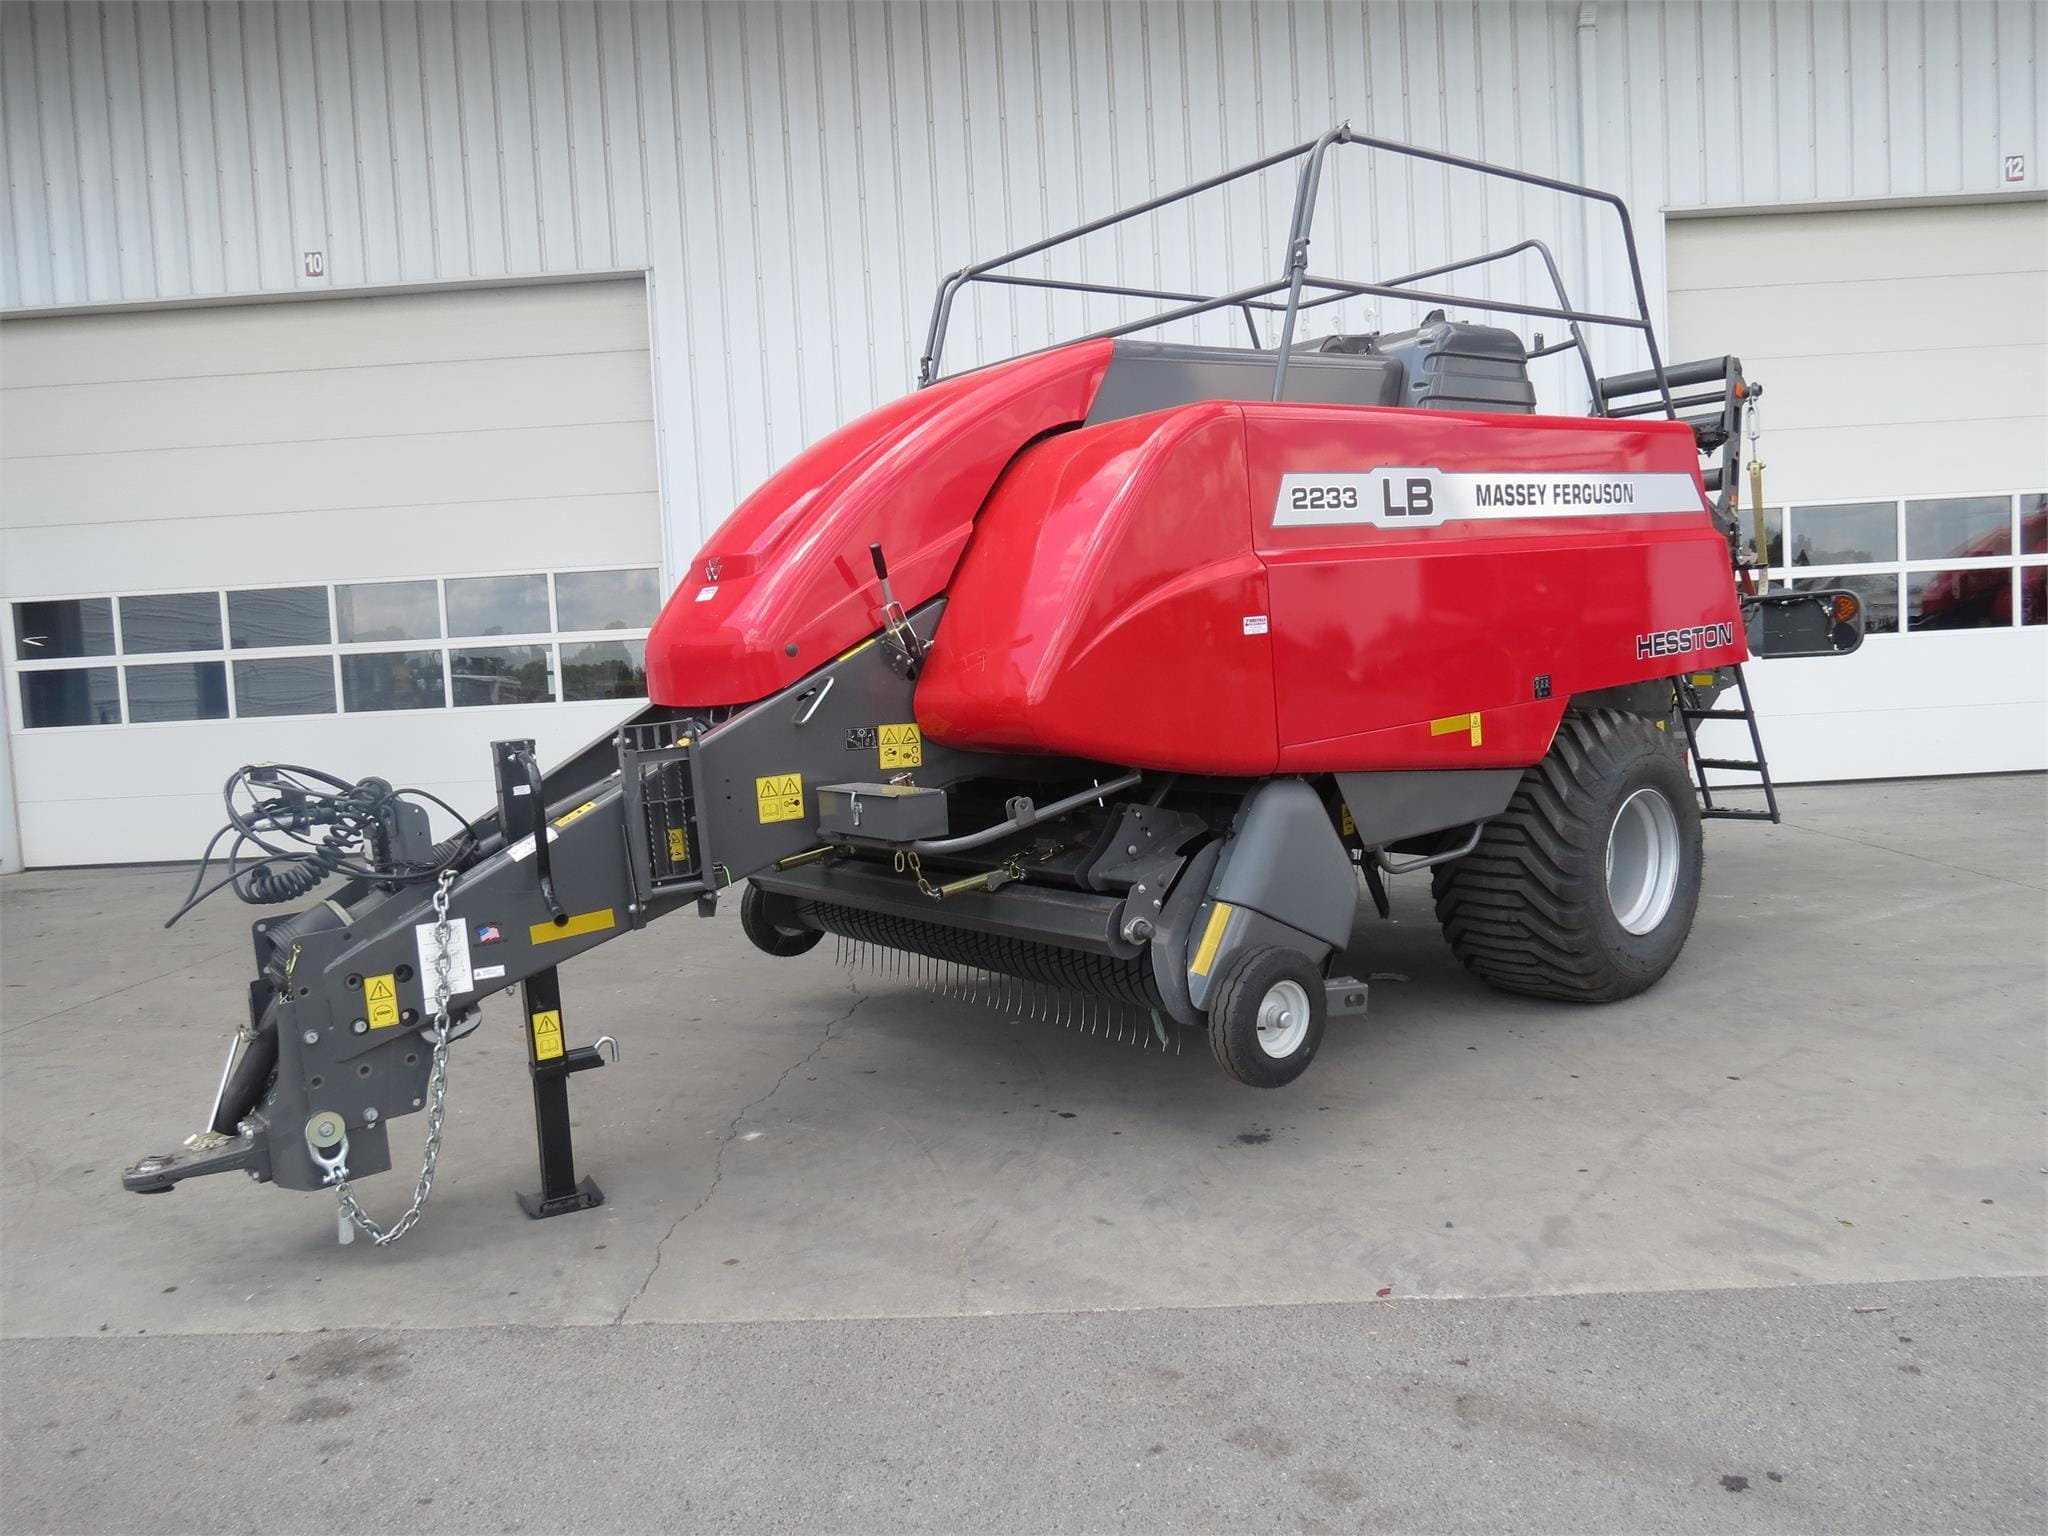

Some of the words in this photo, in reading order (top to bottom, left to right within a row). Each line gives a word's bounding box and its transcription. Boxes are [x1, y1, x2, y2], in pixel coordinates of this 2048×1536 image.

[2005, 158, 2023, 177] 12
[305, 254, 322, 272] 10
[1291, 487, 1358, 510] 2233
[1382, 478, 1434, 517] LB
[1475, 483, 1547, 507] MASSEY
[1552, 483, 1634, 505] FERGUSON
[1636, 622, 1733, 660] HESSTON
